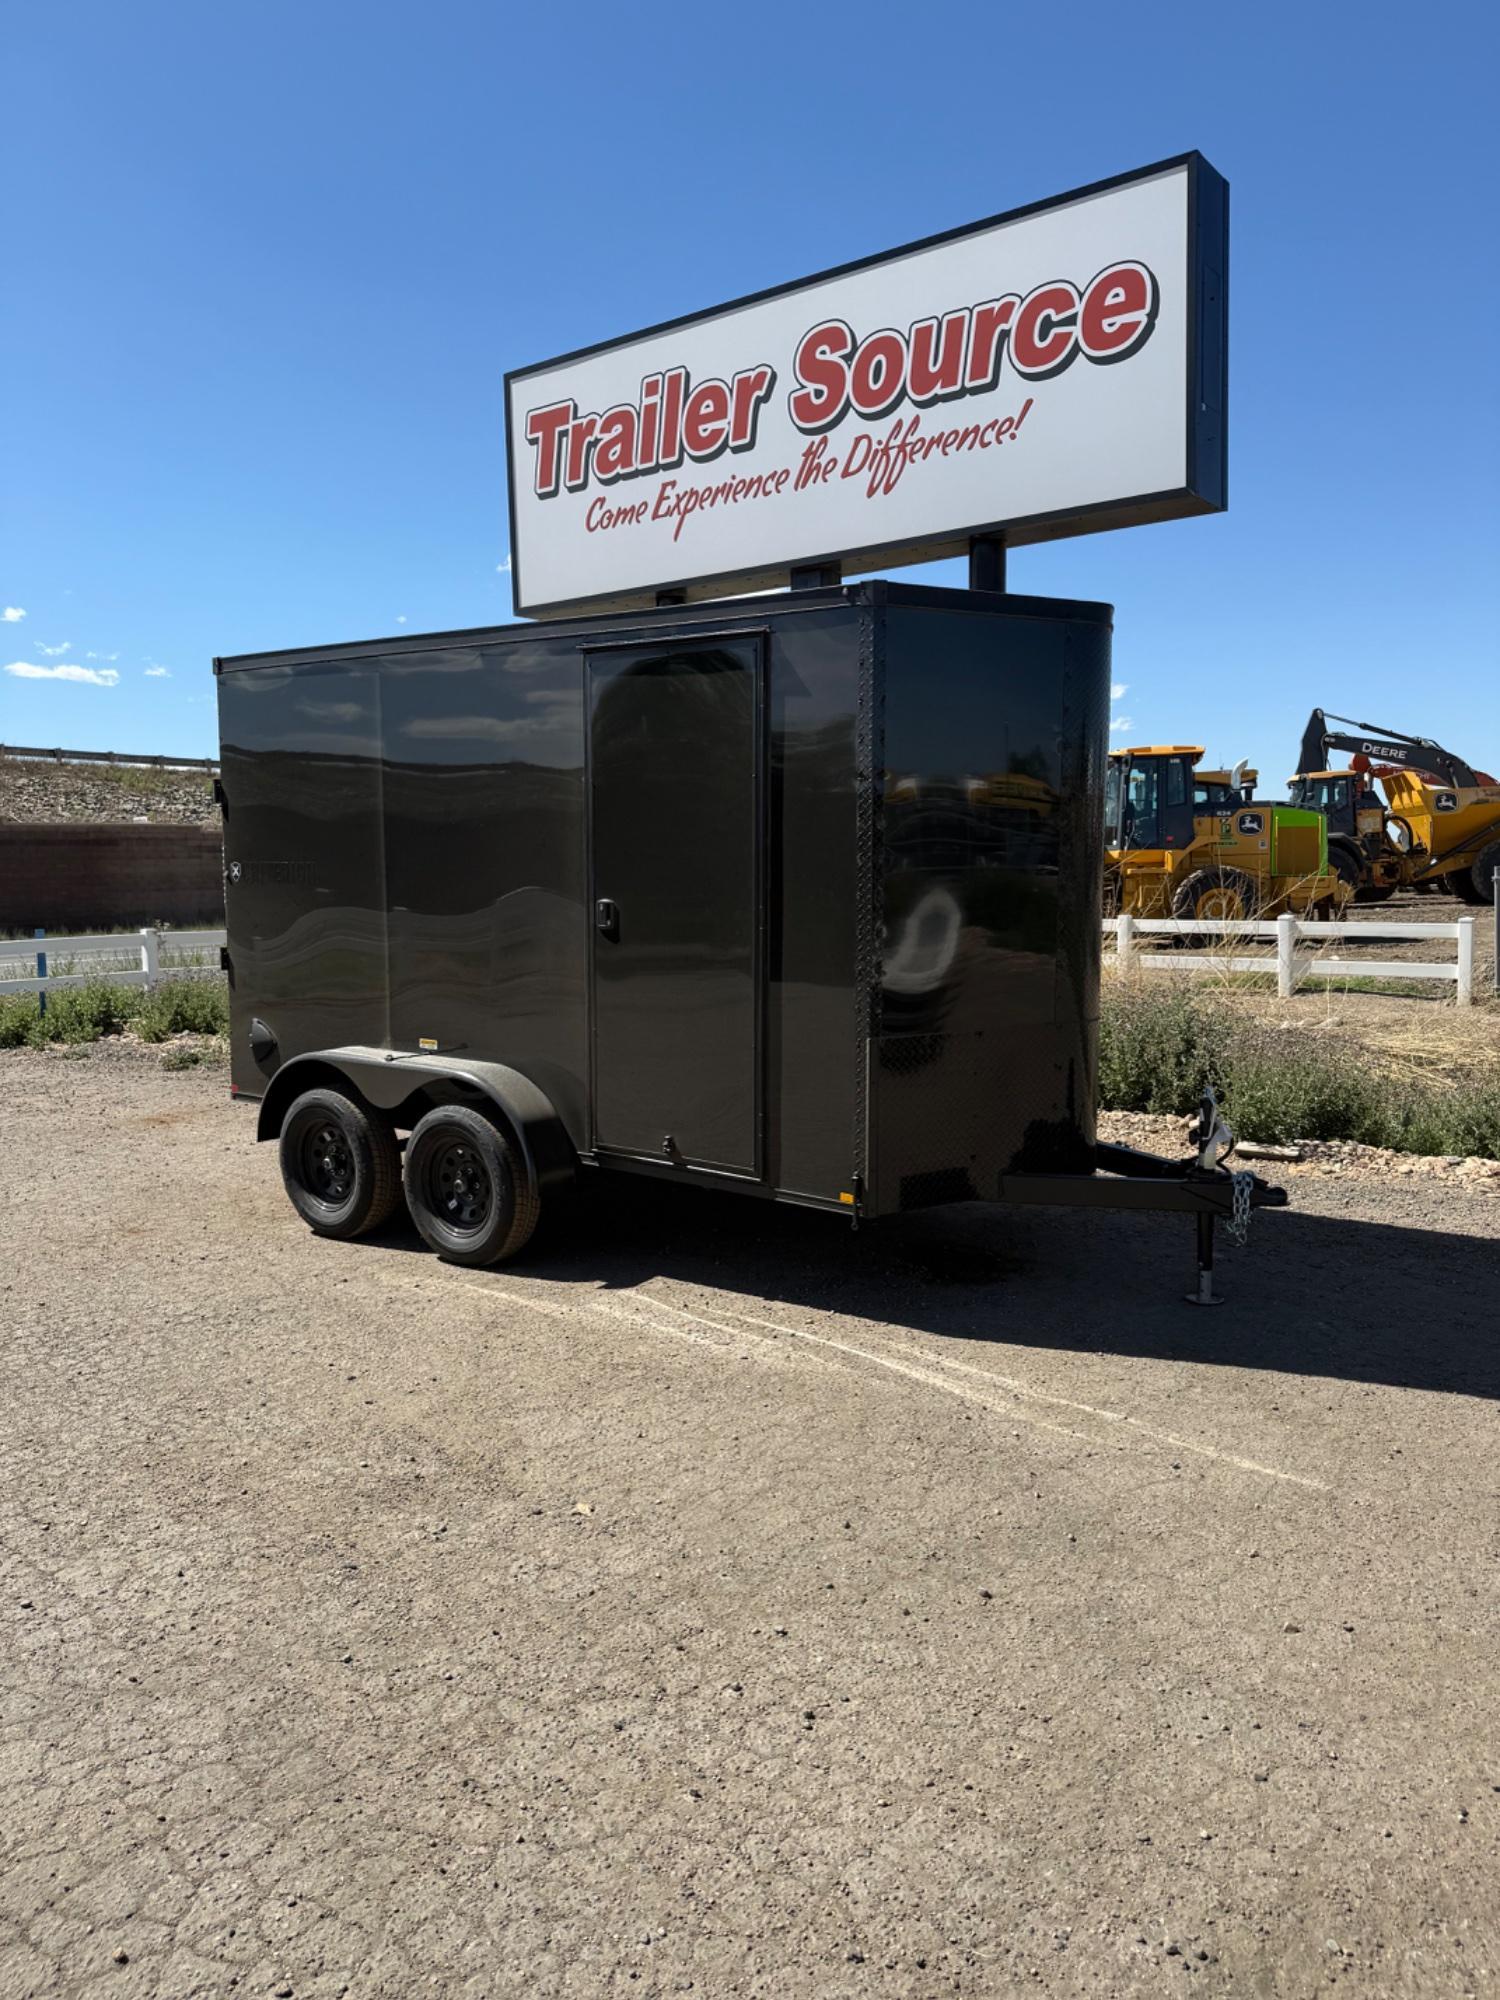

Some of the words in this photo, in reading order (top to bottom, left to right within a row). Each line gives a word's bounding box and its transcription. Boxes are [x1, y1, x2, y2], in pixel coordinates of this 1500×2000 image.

[526, 366, 776, 499] Trailer
[789, 260, 1159, 434] Source
[585, 496, 648, 532] Come
[651, 470, 790, 542] Experience
[794, 435, 837, 491] the
[840, 398, 1033, 498] Difference!
[1361, 742, 1408, 759] DEERE
